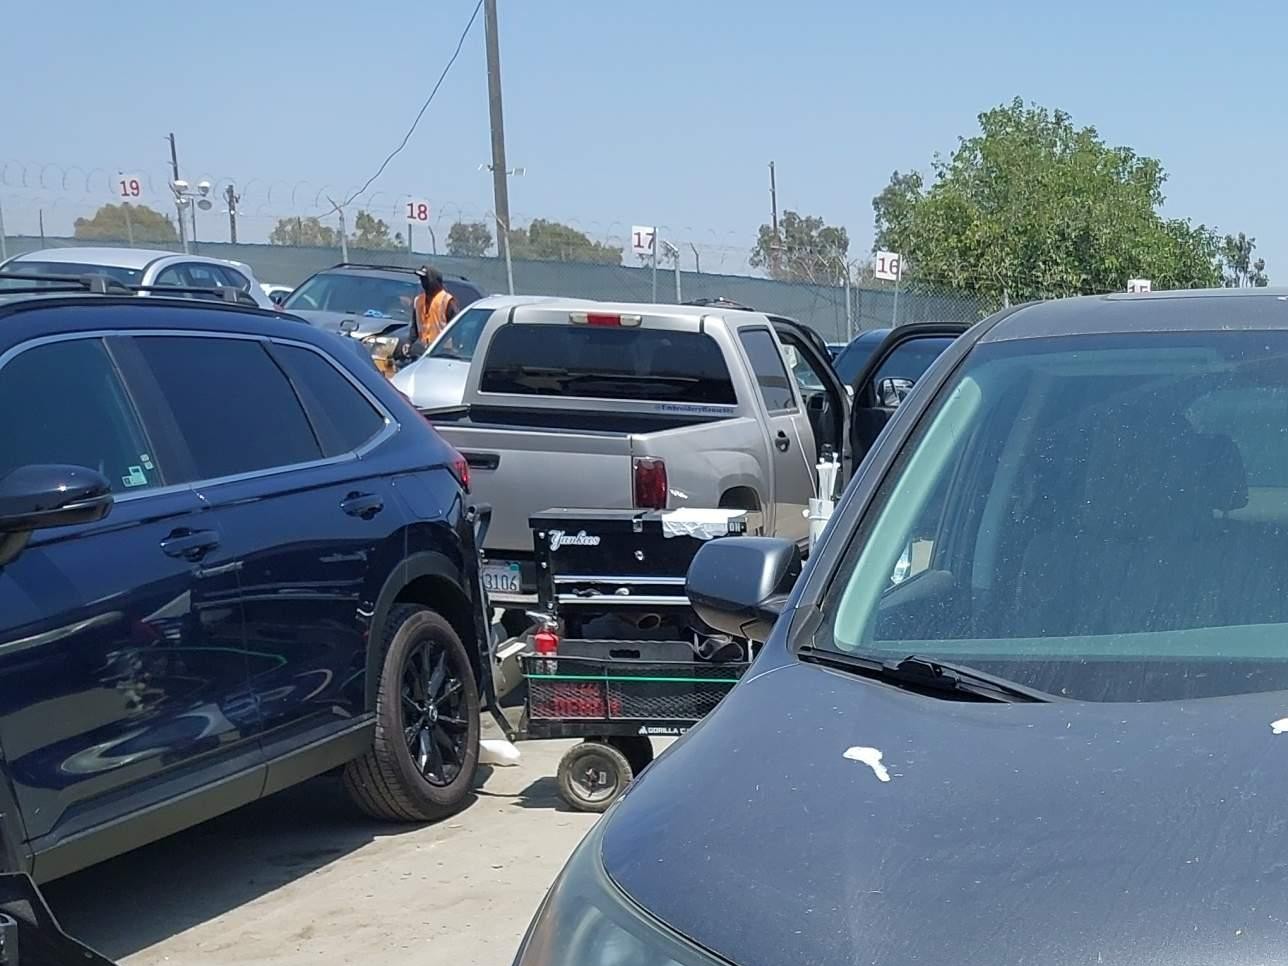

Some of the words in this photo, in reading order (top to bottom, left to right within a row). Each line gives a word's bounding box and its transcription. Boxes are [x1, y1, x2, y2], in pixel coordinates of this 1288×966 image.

[120, 180, 139, 197] 19
[407, 203, 428, 221] 18
[634, 232, 655, 249] 17
[878, 257, 898, 275] 16
